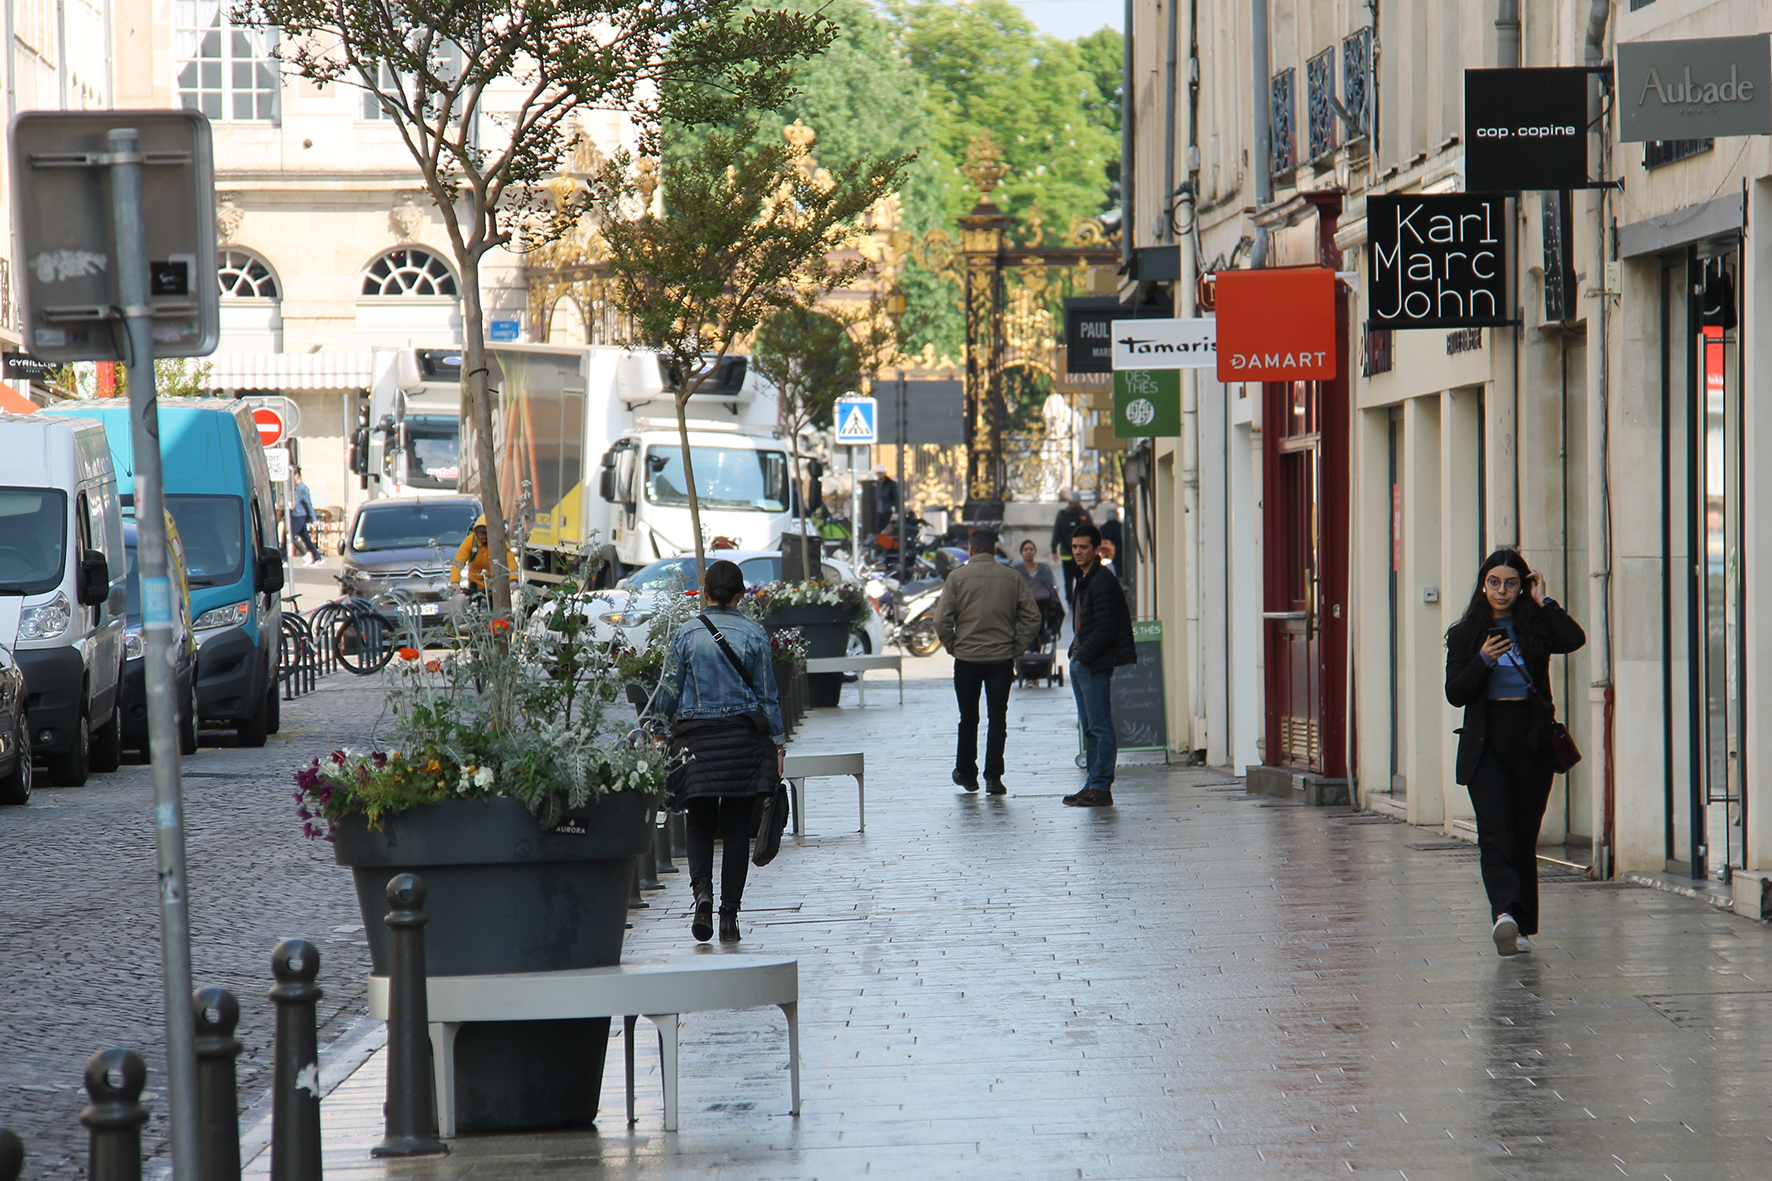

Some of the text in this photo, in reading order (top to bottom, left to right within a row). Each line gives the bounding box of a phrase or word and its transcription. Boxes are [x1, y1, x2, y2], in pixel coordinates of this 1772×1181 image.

[1638, 63, 1755, 106] Aubade
[1680, 106, 1718, 114] PARIS
[1477, 123, 1576, 139] cop.copine
[1396, 203, 1498, 244] Karl
[1375, 242, 1495, 282] Marc
[1377, 278, 1496, 318] John
[1080, 321, 1110, 338] PAUL
[1229, 352, 1327, 369] DAMART
[1064, 373, 1113, 384] BOMP
[1125, 370, 1151, 382] DES
[555, 826, 586, 835] AURORA
